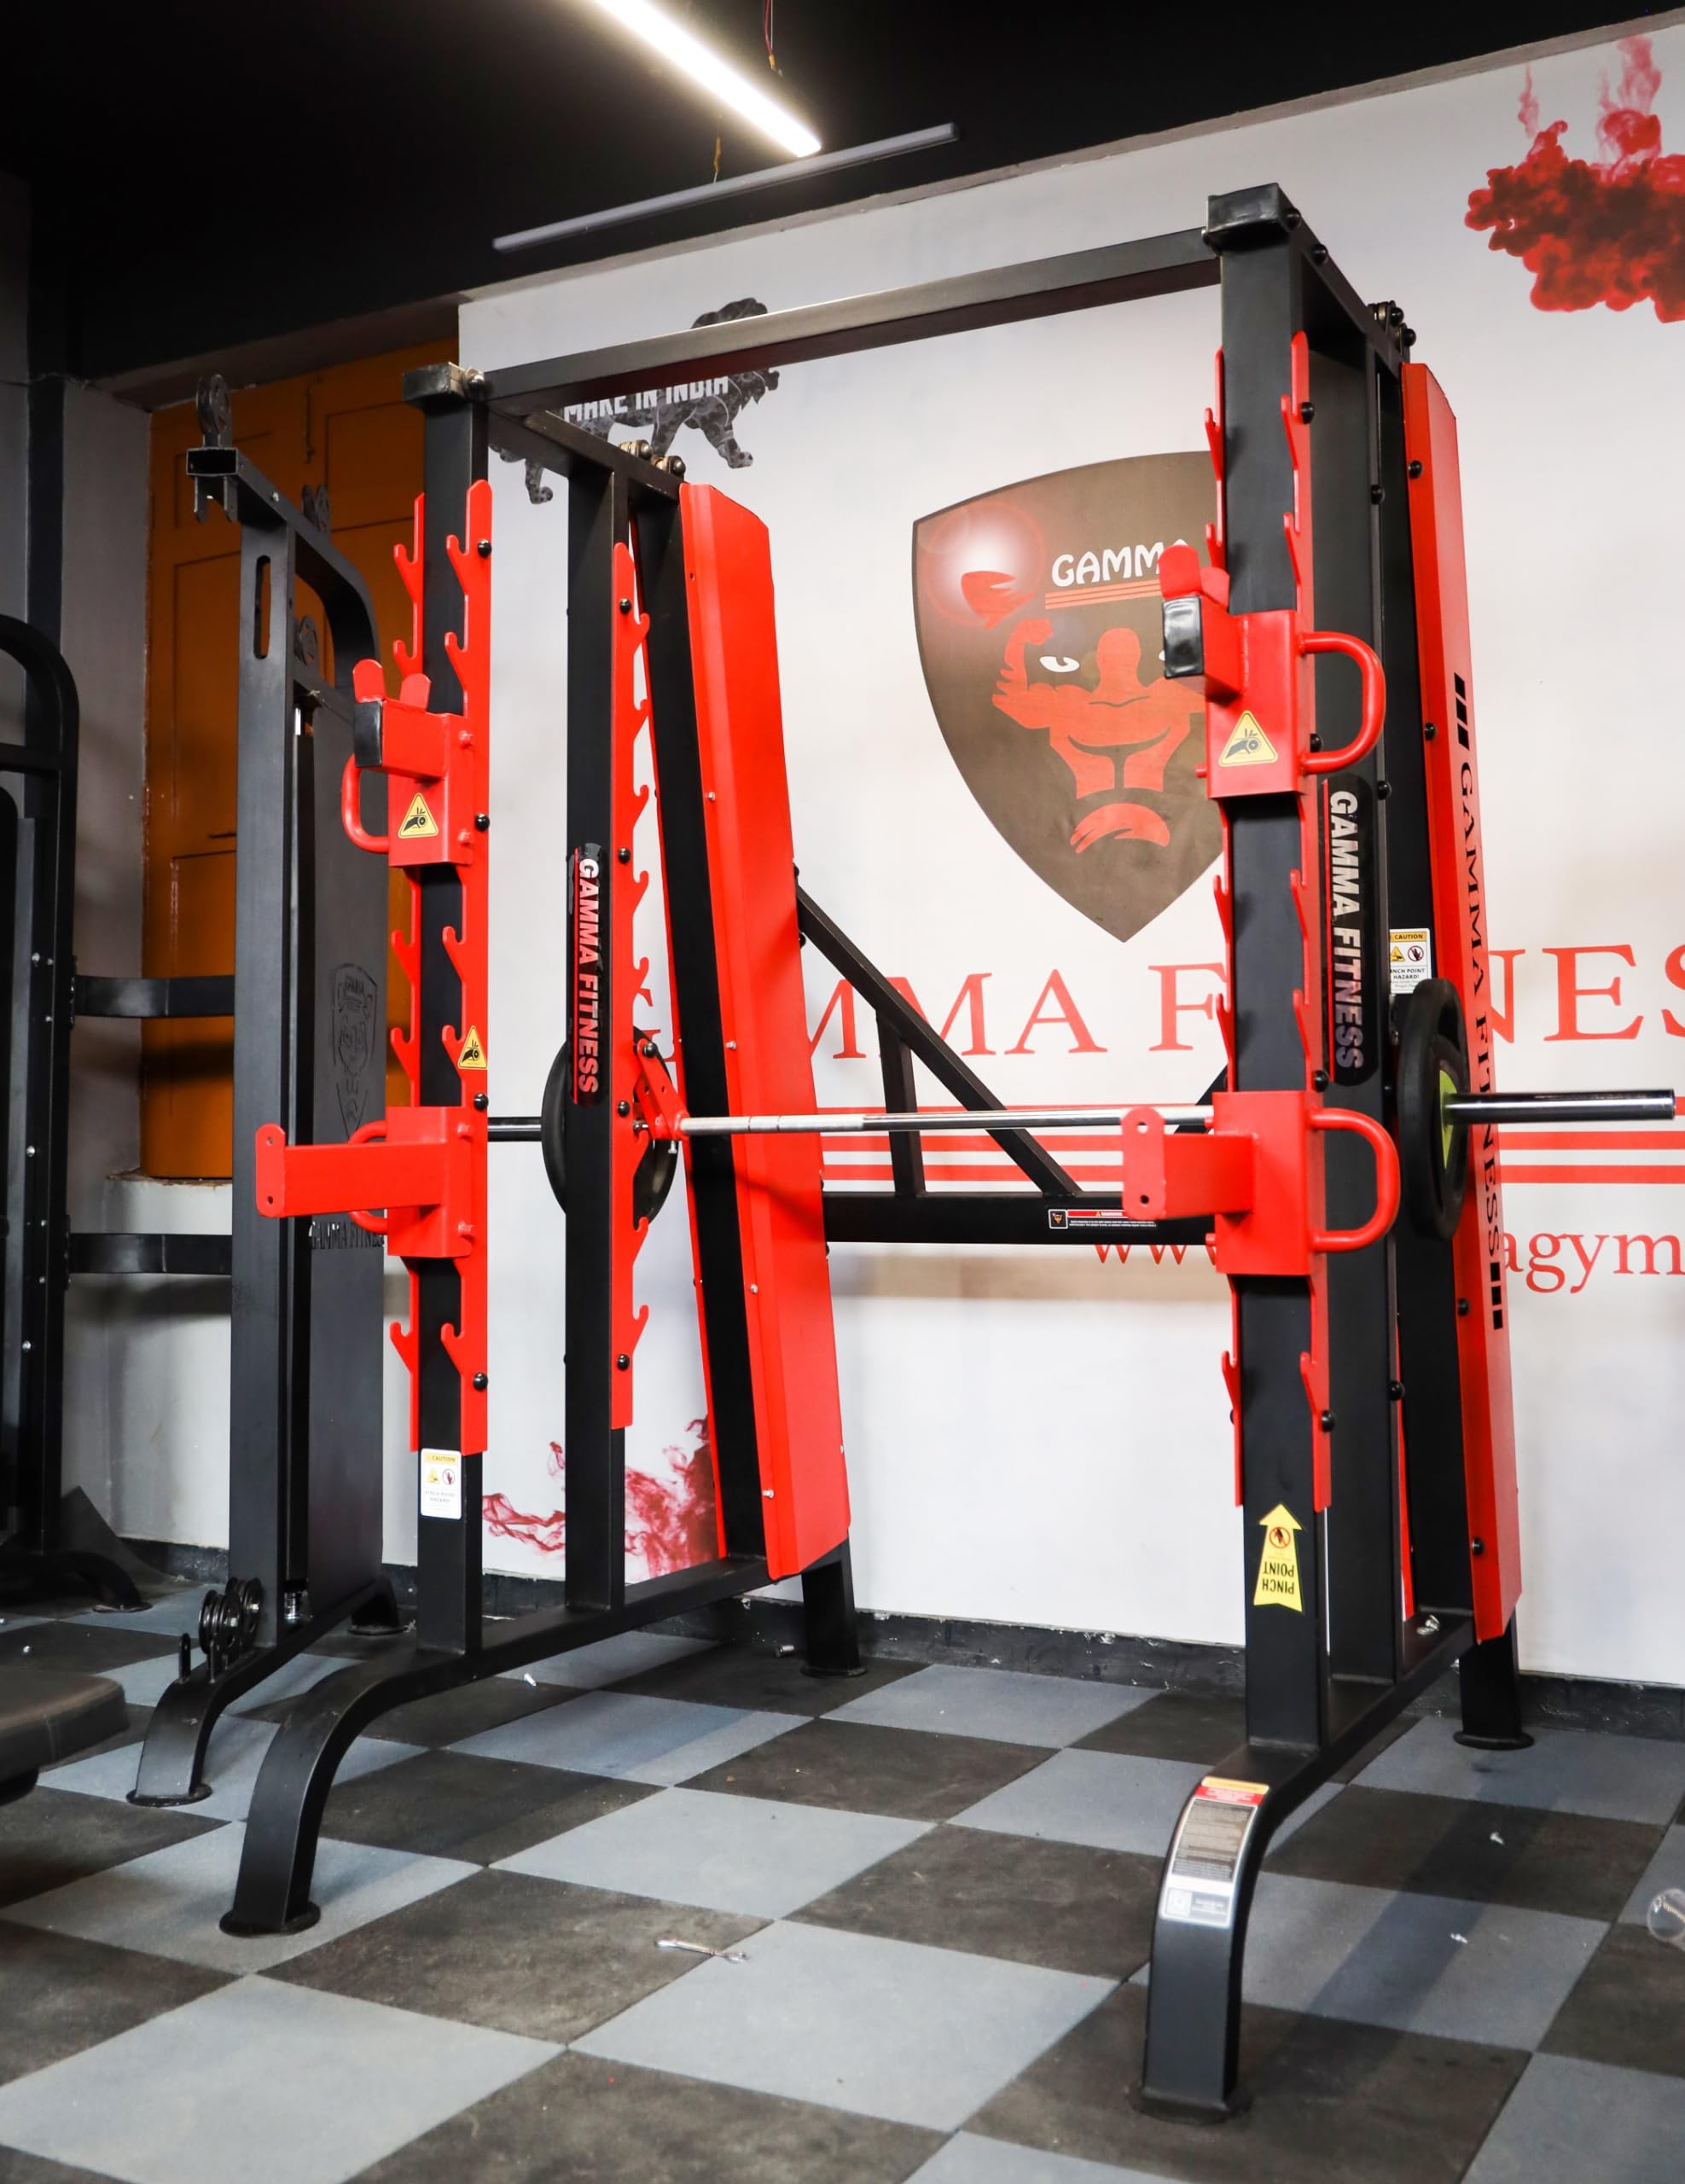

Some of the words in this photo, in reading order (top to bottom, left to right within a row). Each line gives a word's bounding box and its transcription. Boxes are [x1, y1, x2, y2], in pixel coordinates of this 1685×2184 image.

[564, 395, 629, 422] MAKE
[636, 389, 658, 410] IN
[665, 376, 729, 404] INDIA
[1051, 538, 1188, 587] GAMM
[1330, 790, 1360, 917] GAMMA
[1461, 762, 1485, 996] GAMMA
[578, 857, 600, 965] GAMMA
[578, 973, 599, 1093] FITNESS
[1333, 927, 1364, 1069] FITNESS
[1262, 1578, 1295, 1594] PINCH
[1263, 1561, 1295, 1577] POINT
